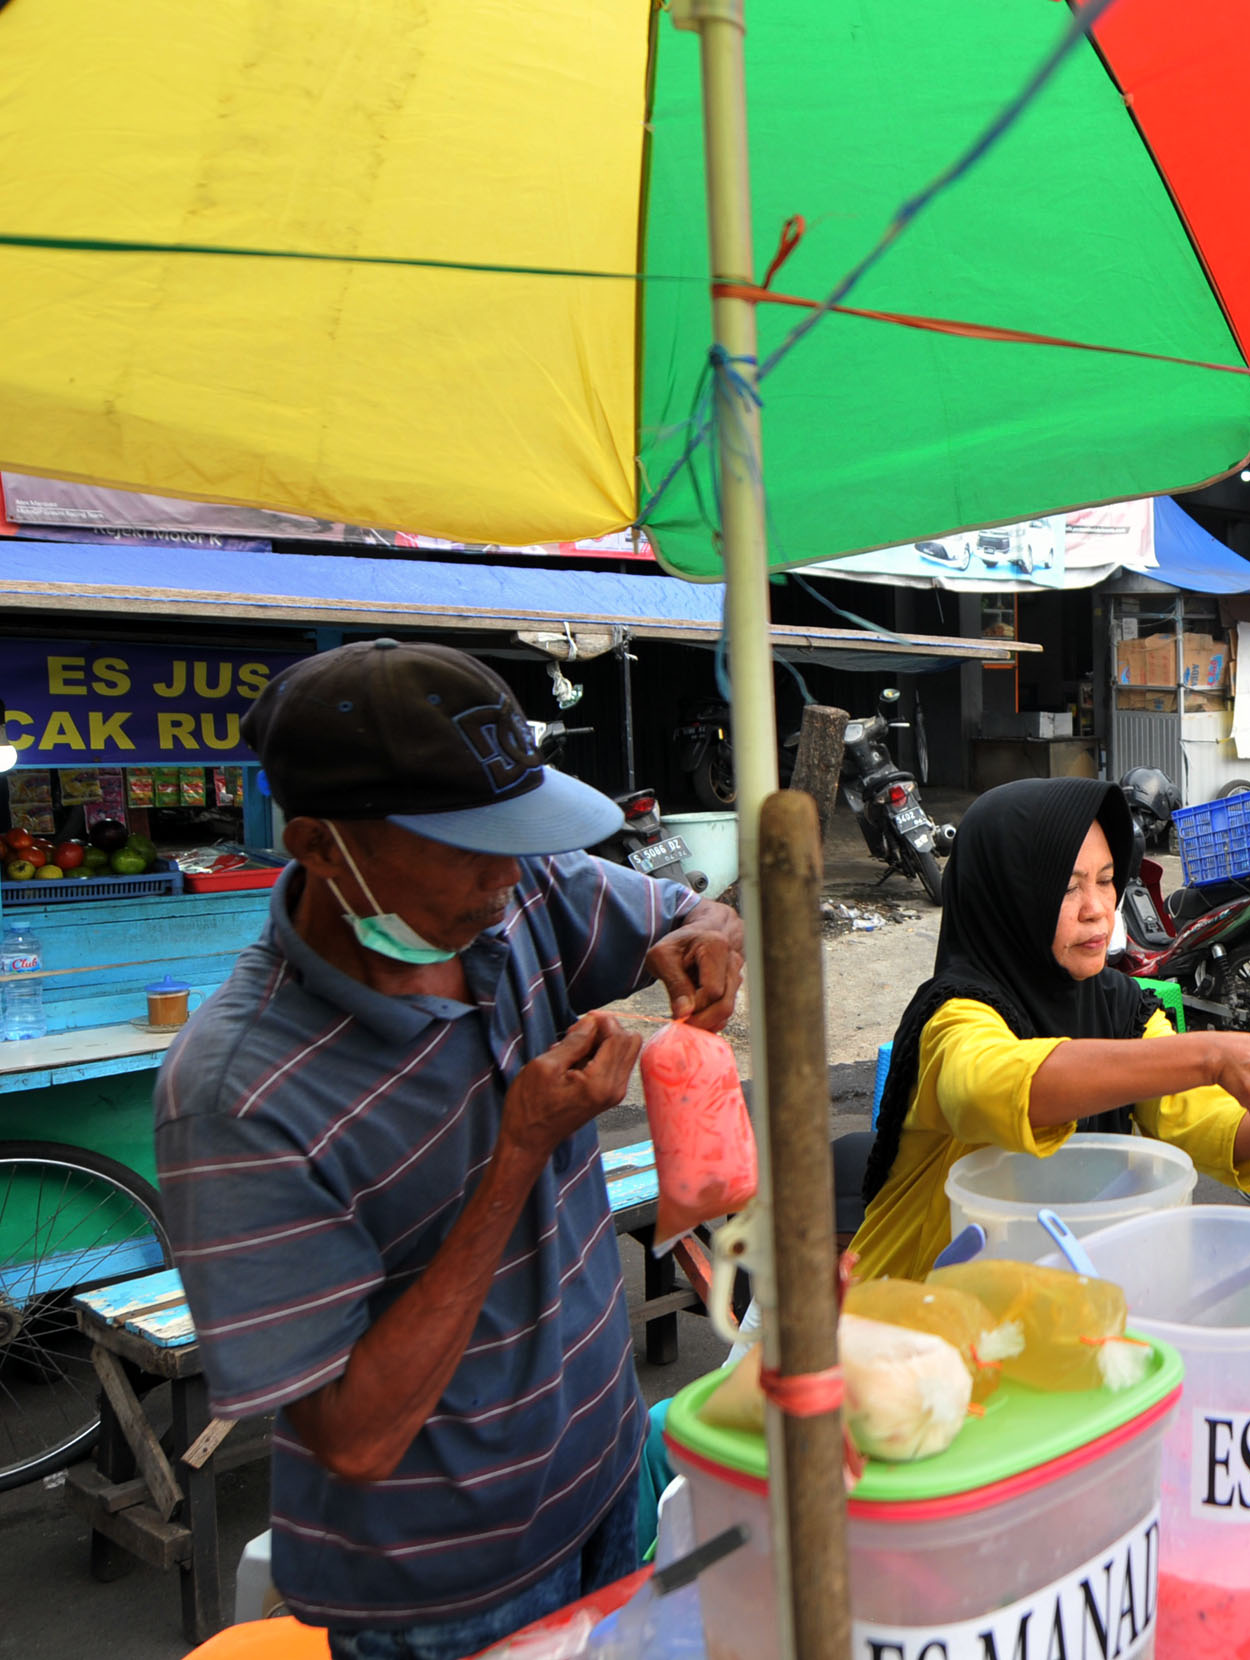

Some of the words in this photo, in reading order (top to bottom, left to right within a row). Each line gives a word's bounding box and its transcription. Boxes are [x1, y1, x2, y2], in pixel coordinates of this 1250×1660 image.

[47, 656, 132, 696] ES
[152, 660, 271, 698] JUS
[5, 710, 136, 750] CAK
[157, 712, 243, 750] RU
[12, 957, 38, 970] Club
